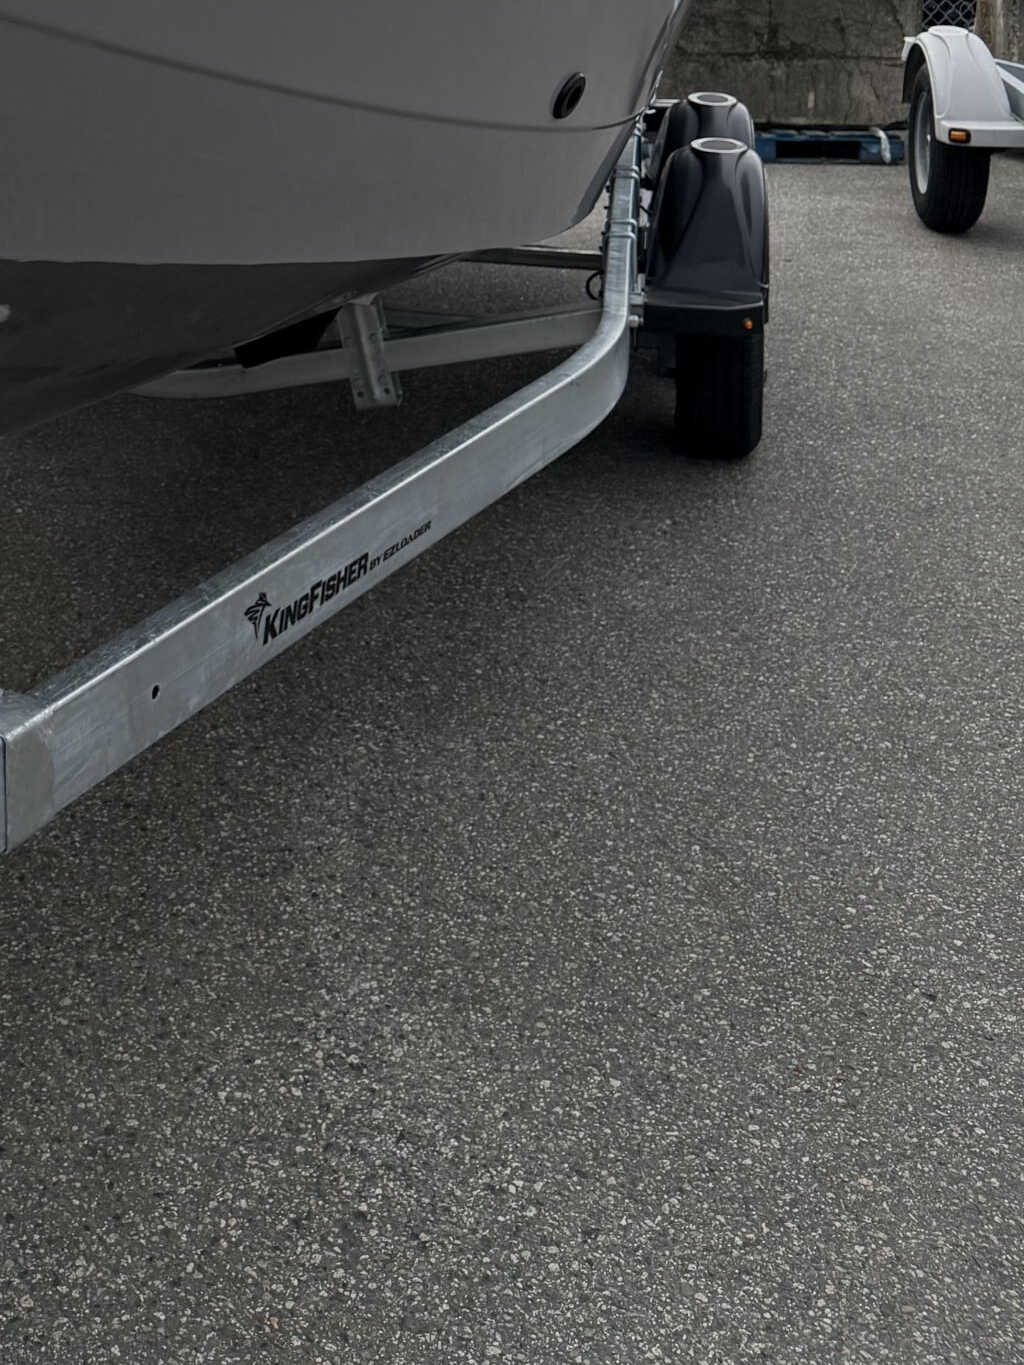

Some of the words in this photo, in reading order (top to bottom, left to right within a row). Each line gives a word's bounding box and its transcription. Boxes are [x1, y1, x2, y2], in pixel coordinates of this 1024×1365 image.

[262, 552, 369, 646] KINGFISHER
[369, 558, 383, 570] BY
[382, 520, 432, 562] EZLOADER
